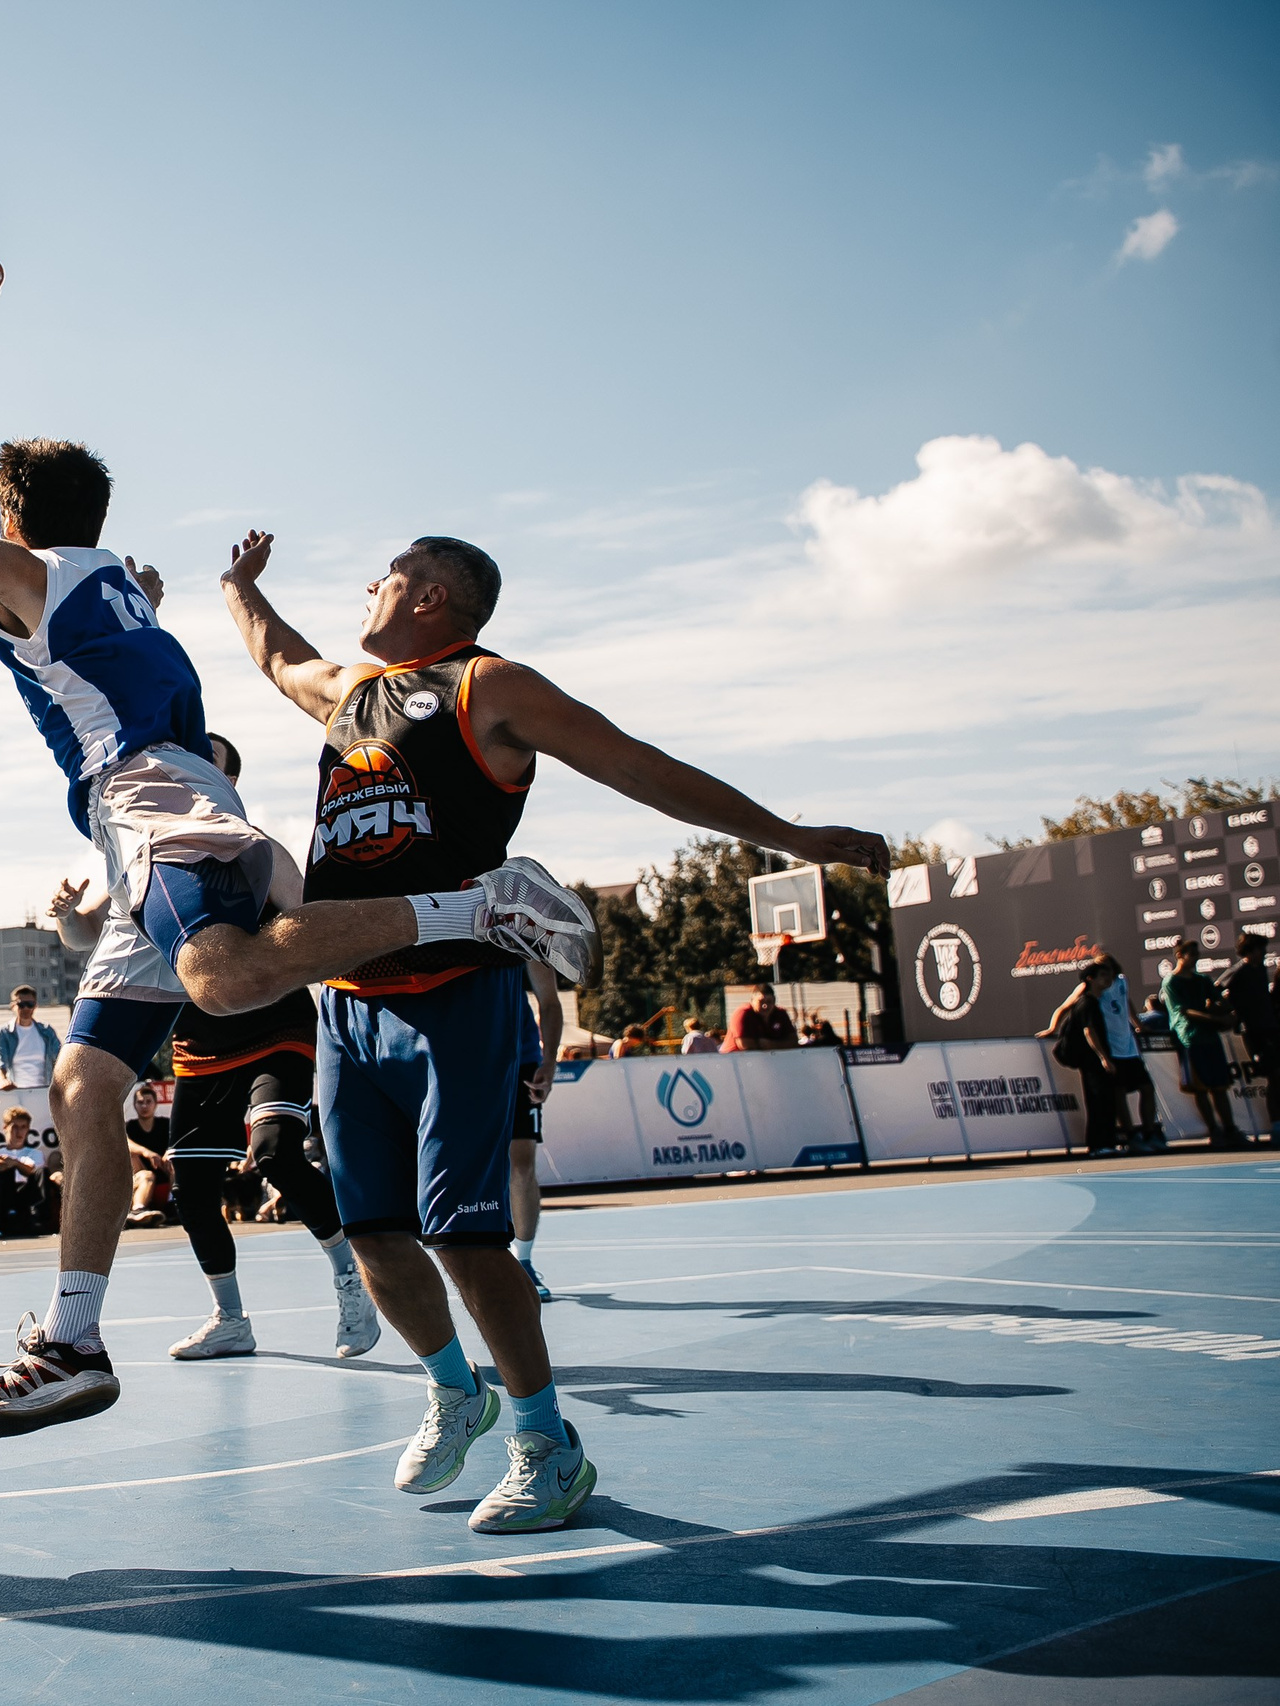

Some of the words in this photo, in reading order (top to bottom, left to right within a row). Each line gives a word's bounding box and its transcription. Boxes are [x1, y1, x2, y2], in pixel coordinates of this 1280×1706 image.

[409, 700, 433, 710] РФБ
[320, 782, 410, 817] ОРАНЖЕВЫЙ
[313, 800, 433, 865] МЯЧ
[956, 1075, 1008, 1098] ТВЕРСКОЙ
[1008, 1076, 1042, 1096] ЦЕНТР
[961, 1098, 1015, 1118] УЛИЧНОГО
[1016, 1093, 1080, 1114] БАСКЕТБОЛА
[653, 1139, 747, 1165] АКВА-ЛАЙФ
[457, 1202, 478, 1214] Sand
[480, 1200, 500, 1212] Knit
